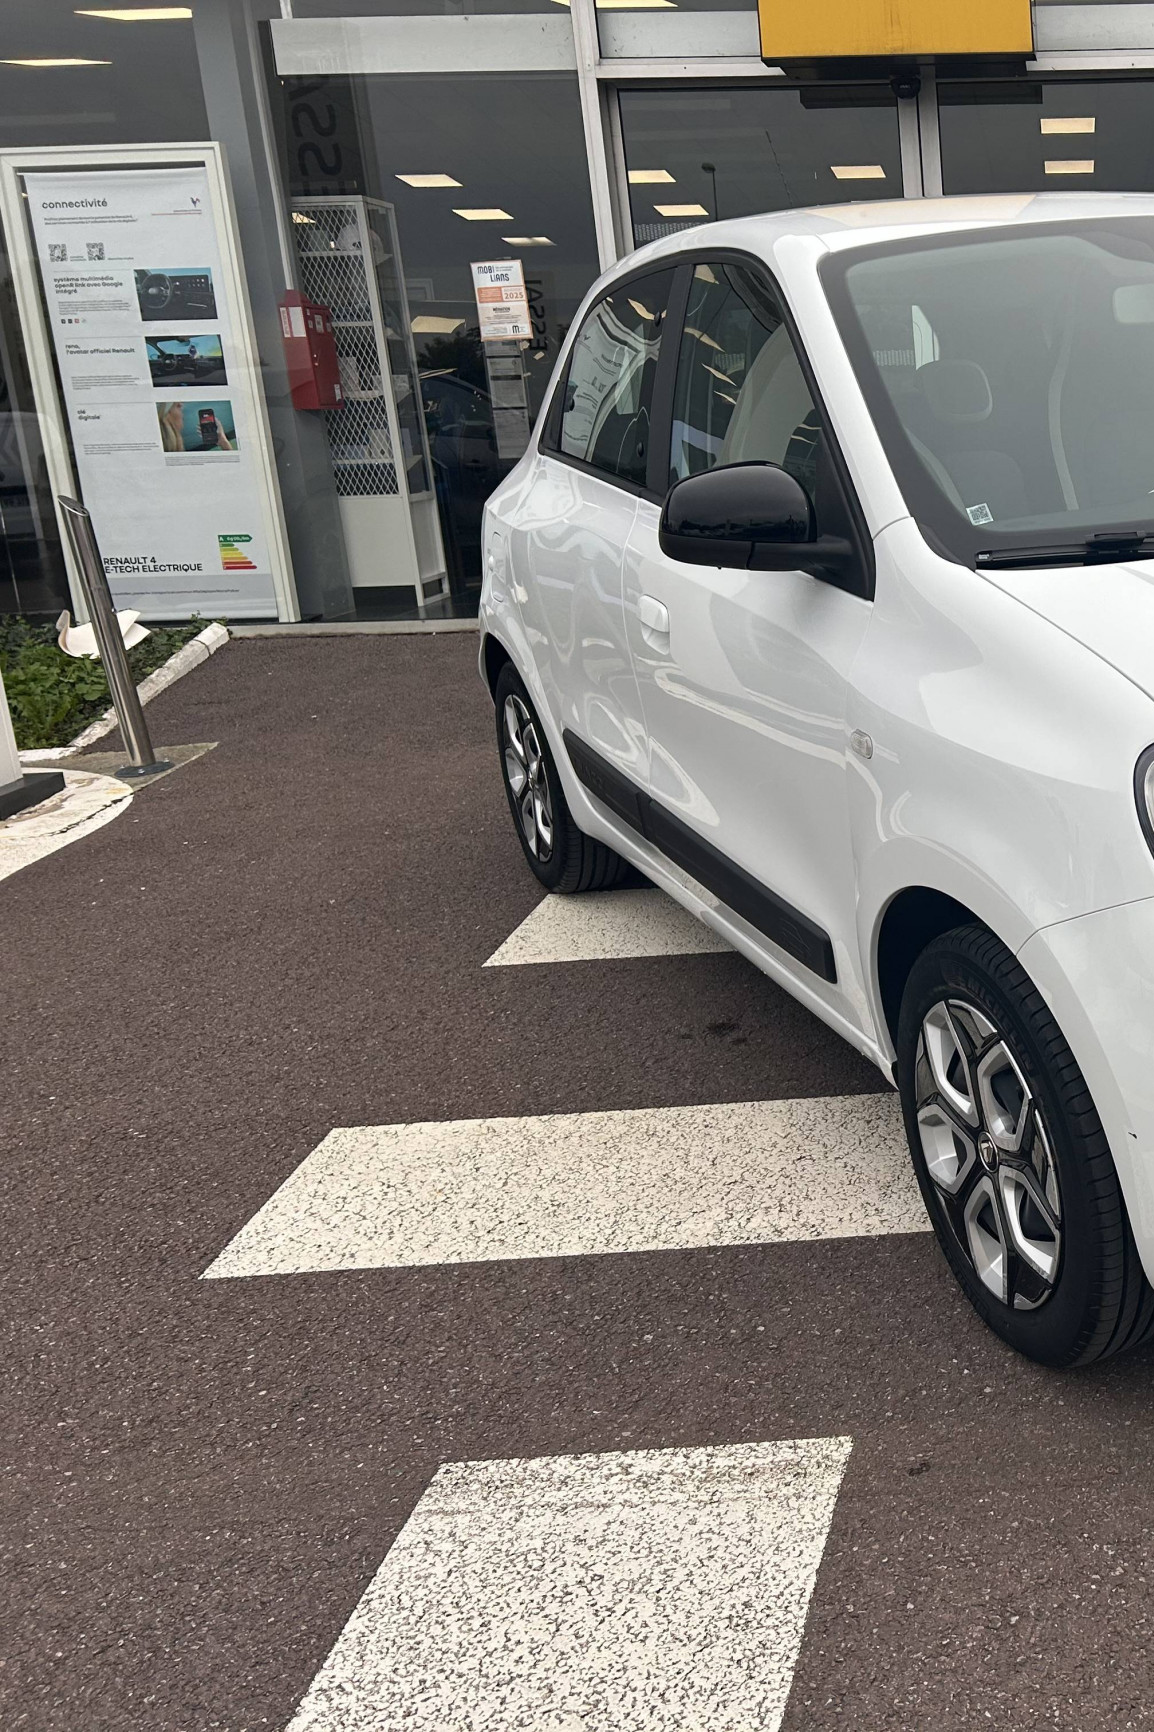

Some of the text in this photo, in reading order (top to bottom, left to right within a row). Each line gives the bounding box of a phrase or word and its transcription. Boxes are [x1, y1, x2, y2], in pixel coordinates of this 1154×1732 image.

[42, 198, 108, 209] connectivité
[103, 556, 157, 565] RENAULT 4
[105, 563, 203, 573] E-TECH ELECTRIQUE
